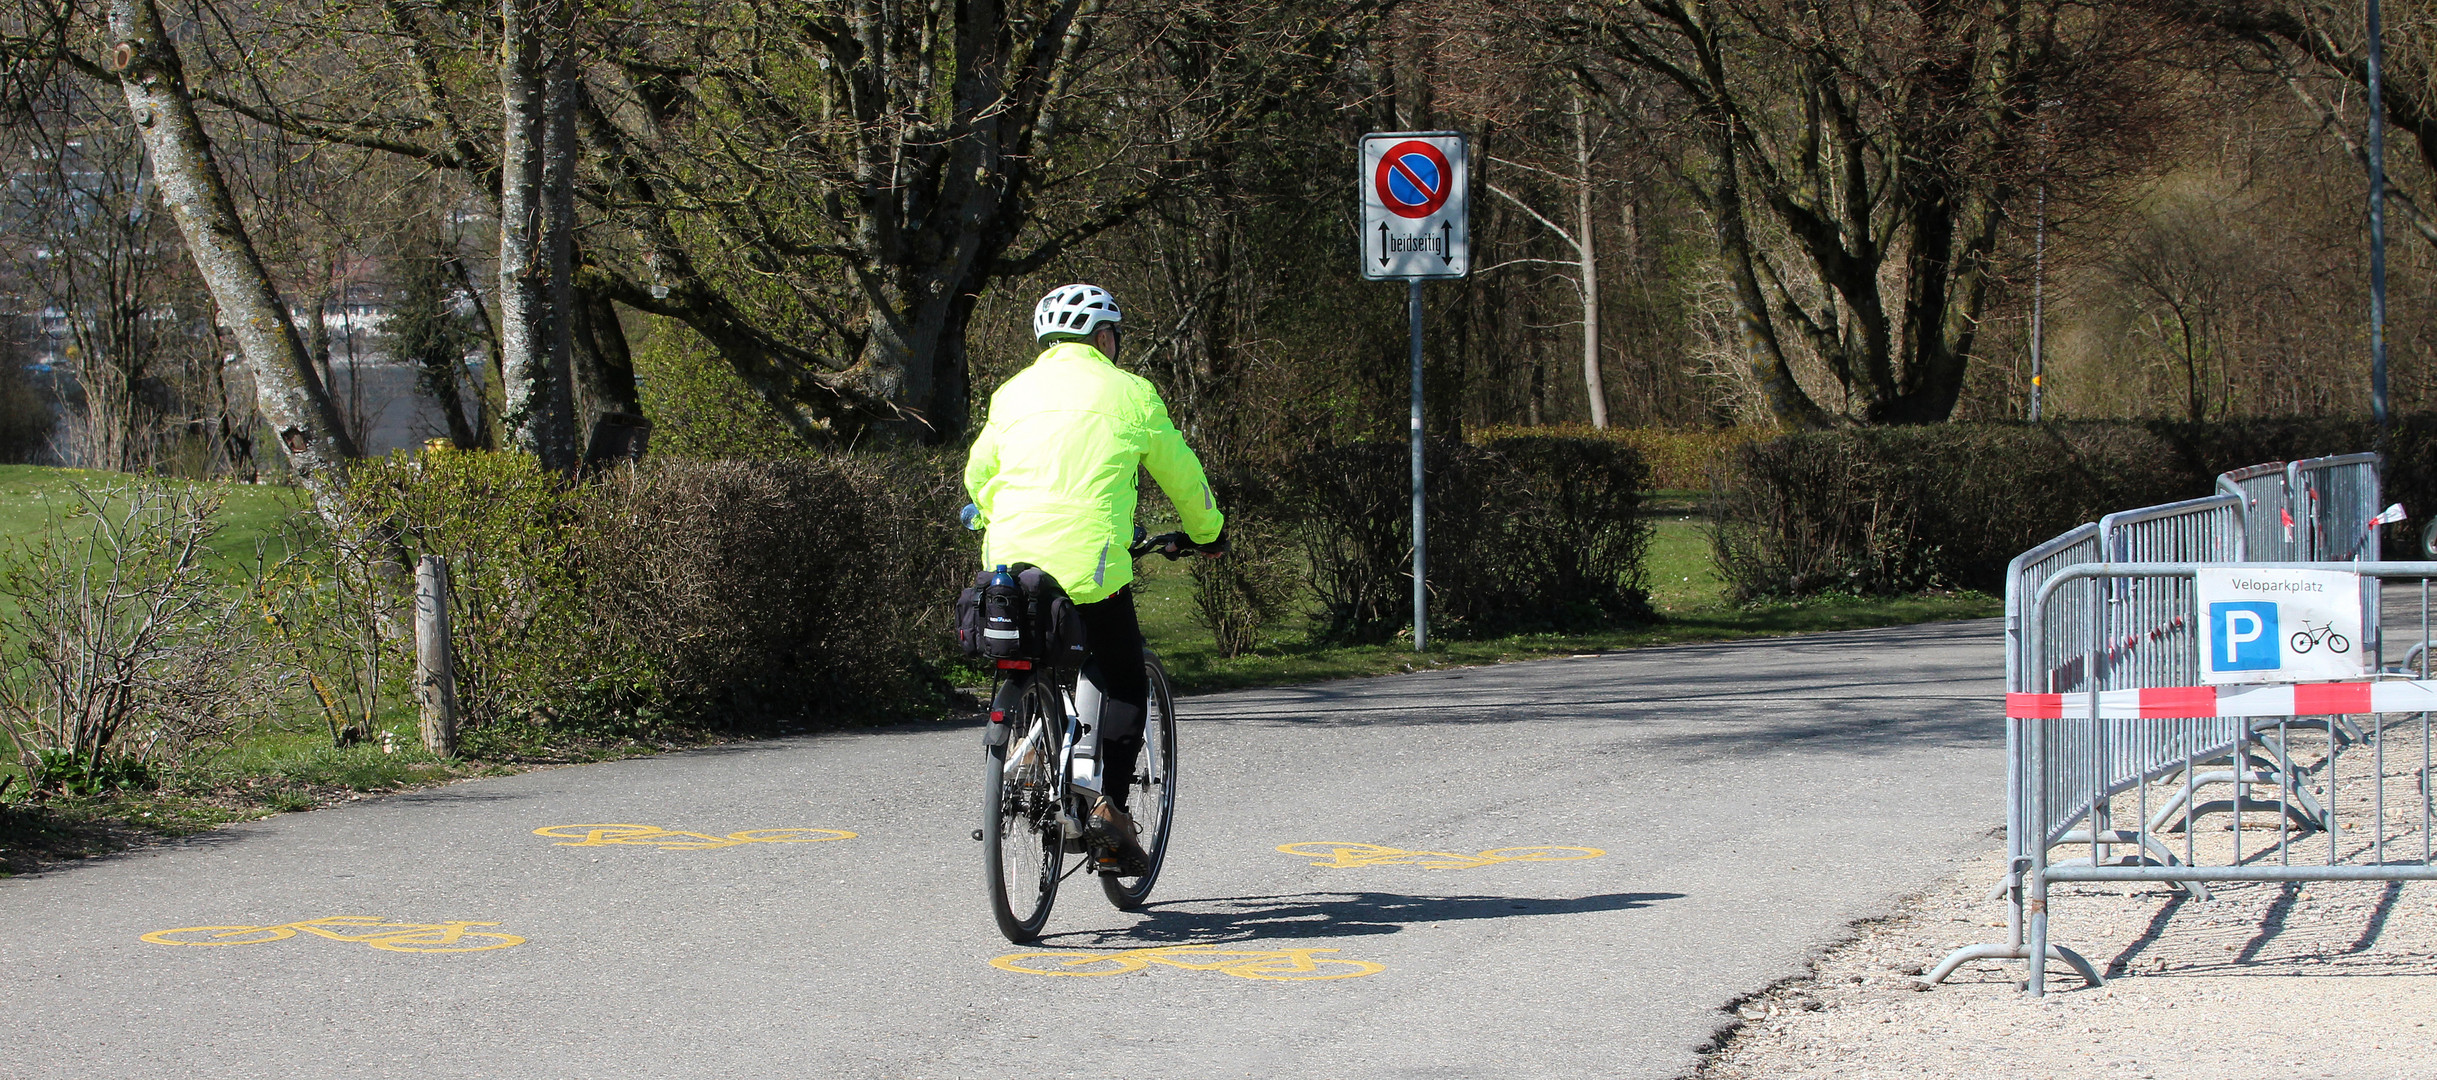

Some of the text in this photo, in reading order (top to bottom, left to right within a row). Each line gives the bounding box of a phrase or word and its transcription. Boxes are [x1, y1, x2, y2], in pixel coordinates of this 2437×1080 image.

[1390, 233, 1441, 256] beidseitig
[2231, 578, 2324, 594] Veloparkplatz
[2225, 610, 2264, 663] P
